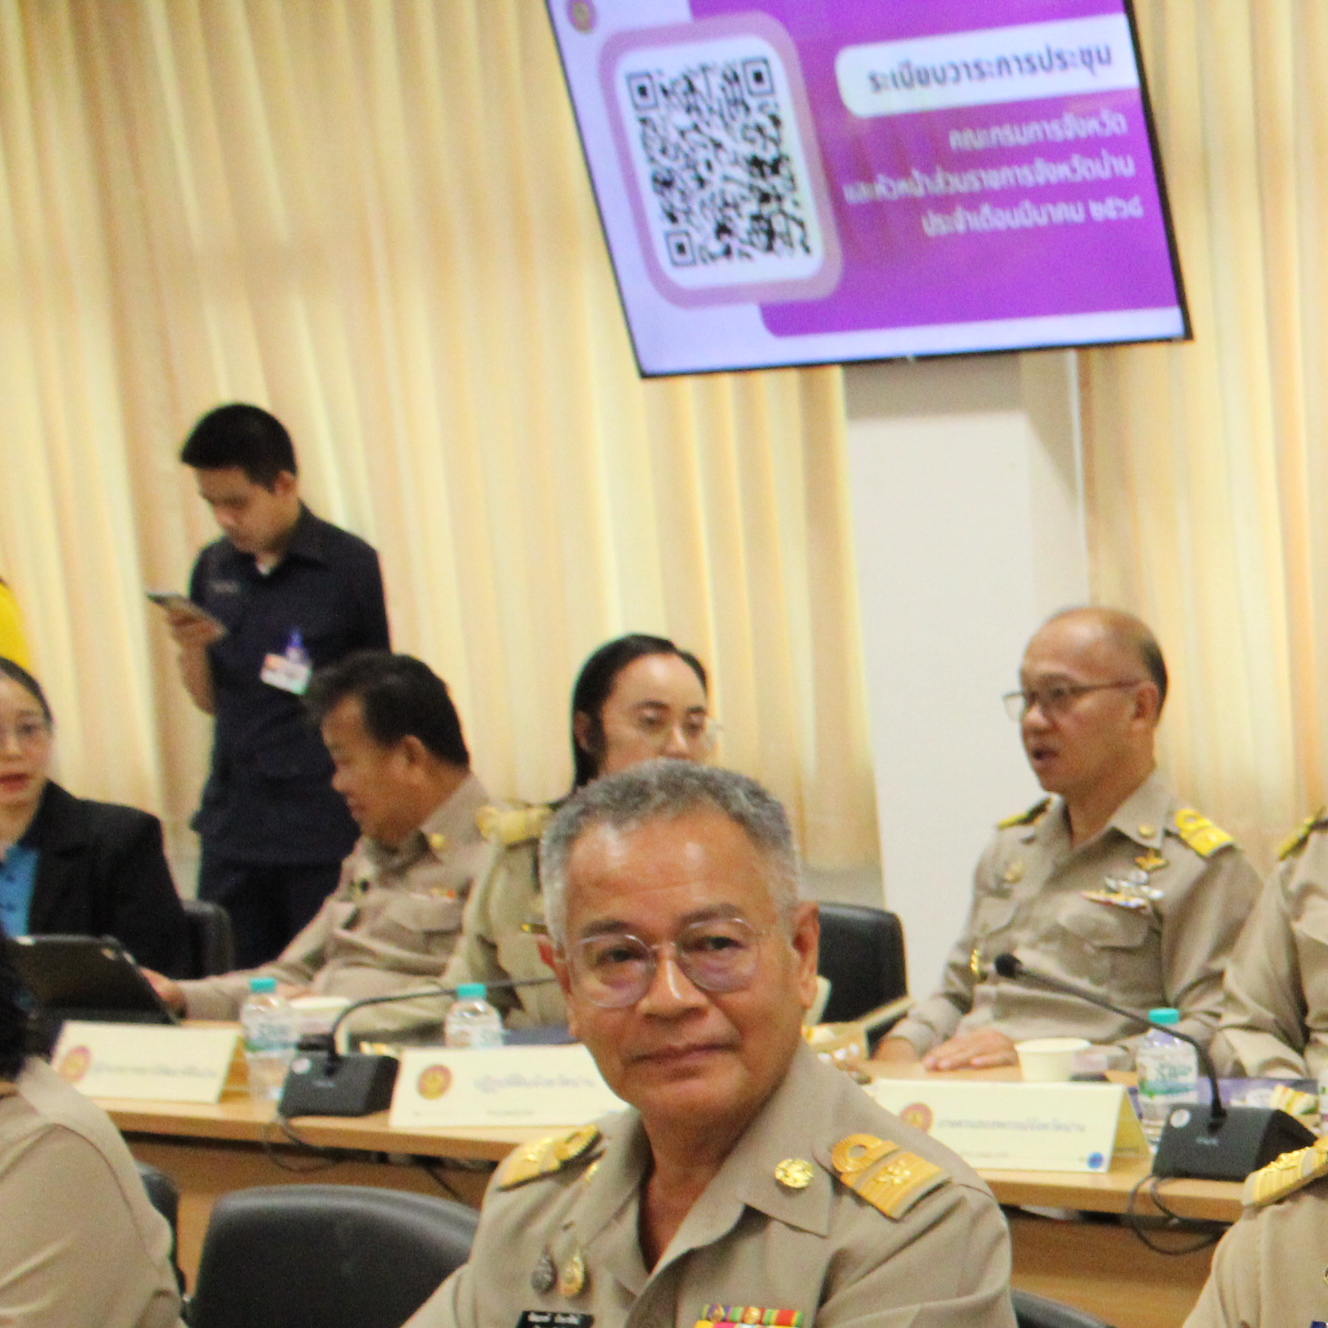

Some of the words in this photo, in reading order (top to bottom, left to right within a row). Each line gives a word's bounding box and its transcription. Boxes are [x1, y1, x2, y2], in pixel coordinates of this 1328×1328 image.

[867, 44, 1112, 93] ระเบียบวาระการประชุม
[921, 200, 1085, 238] ประจำเดือนมีนาคม
